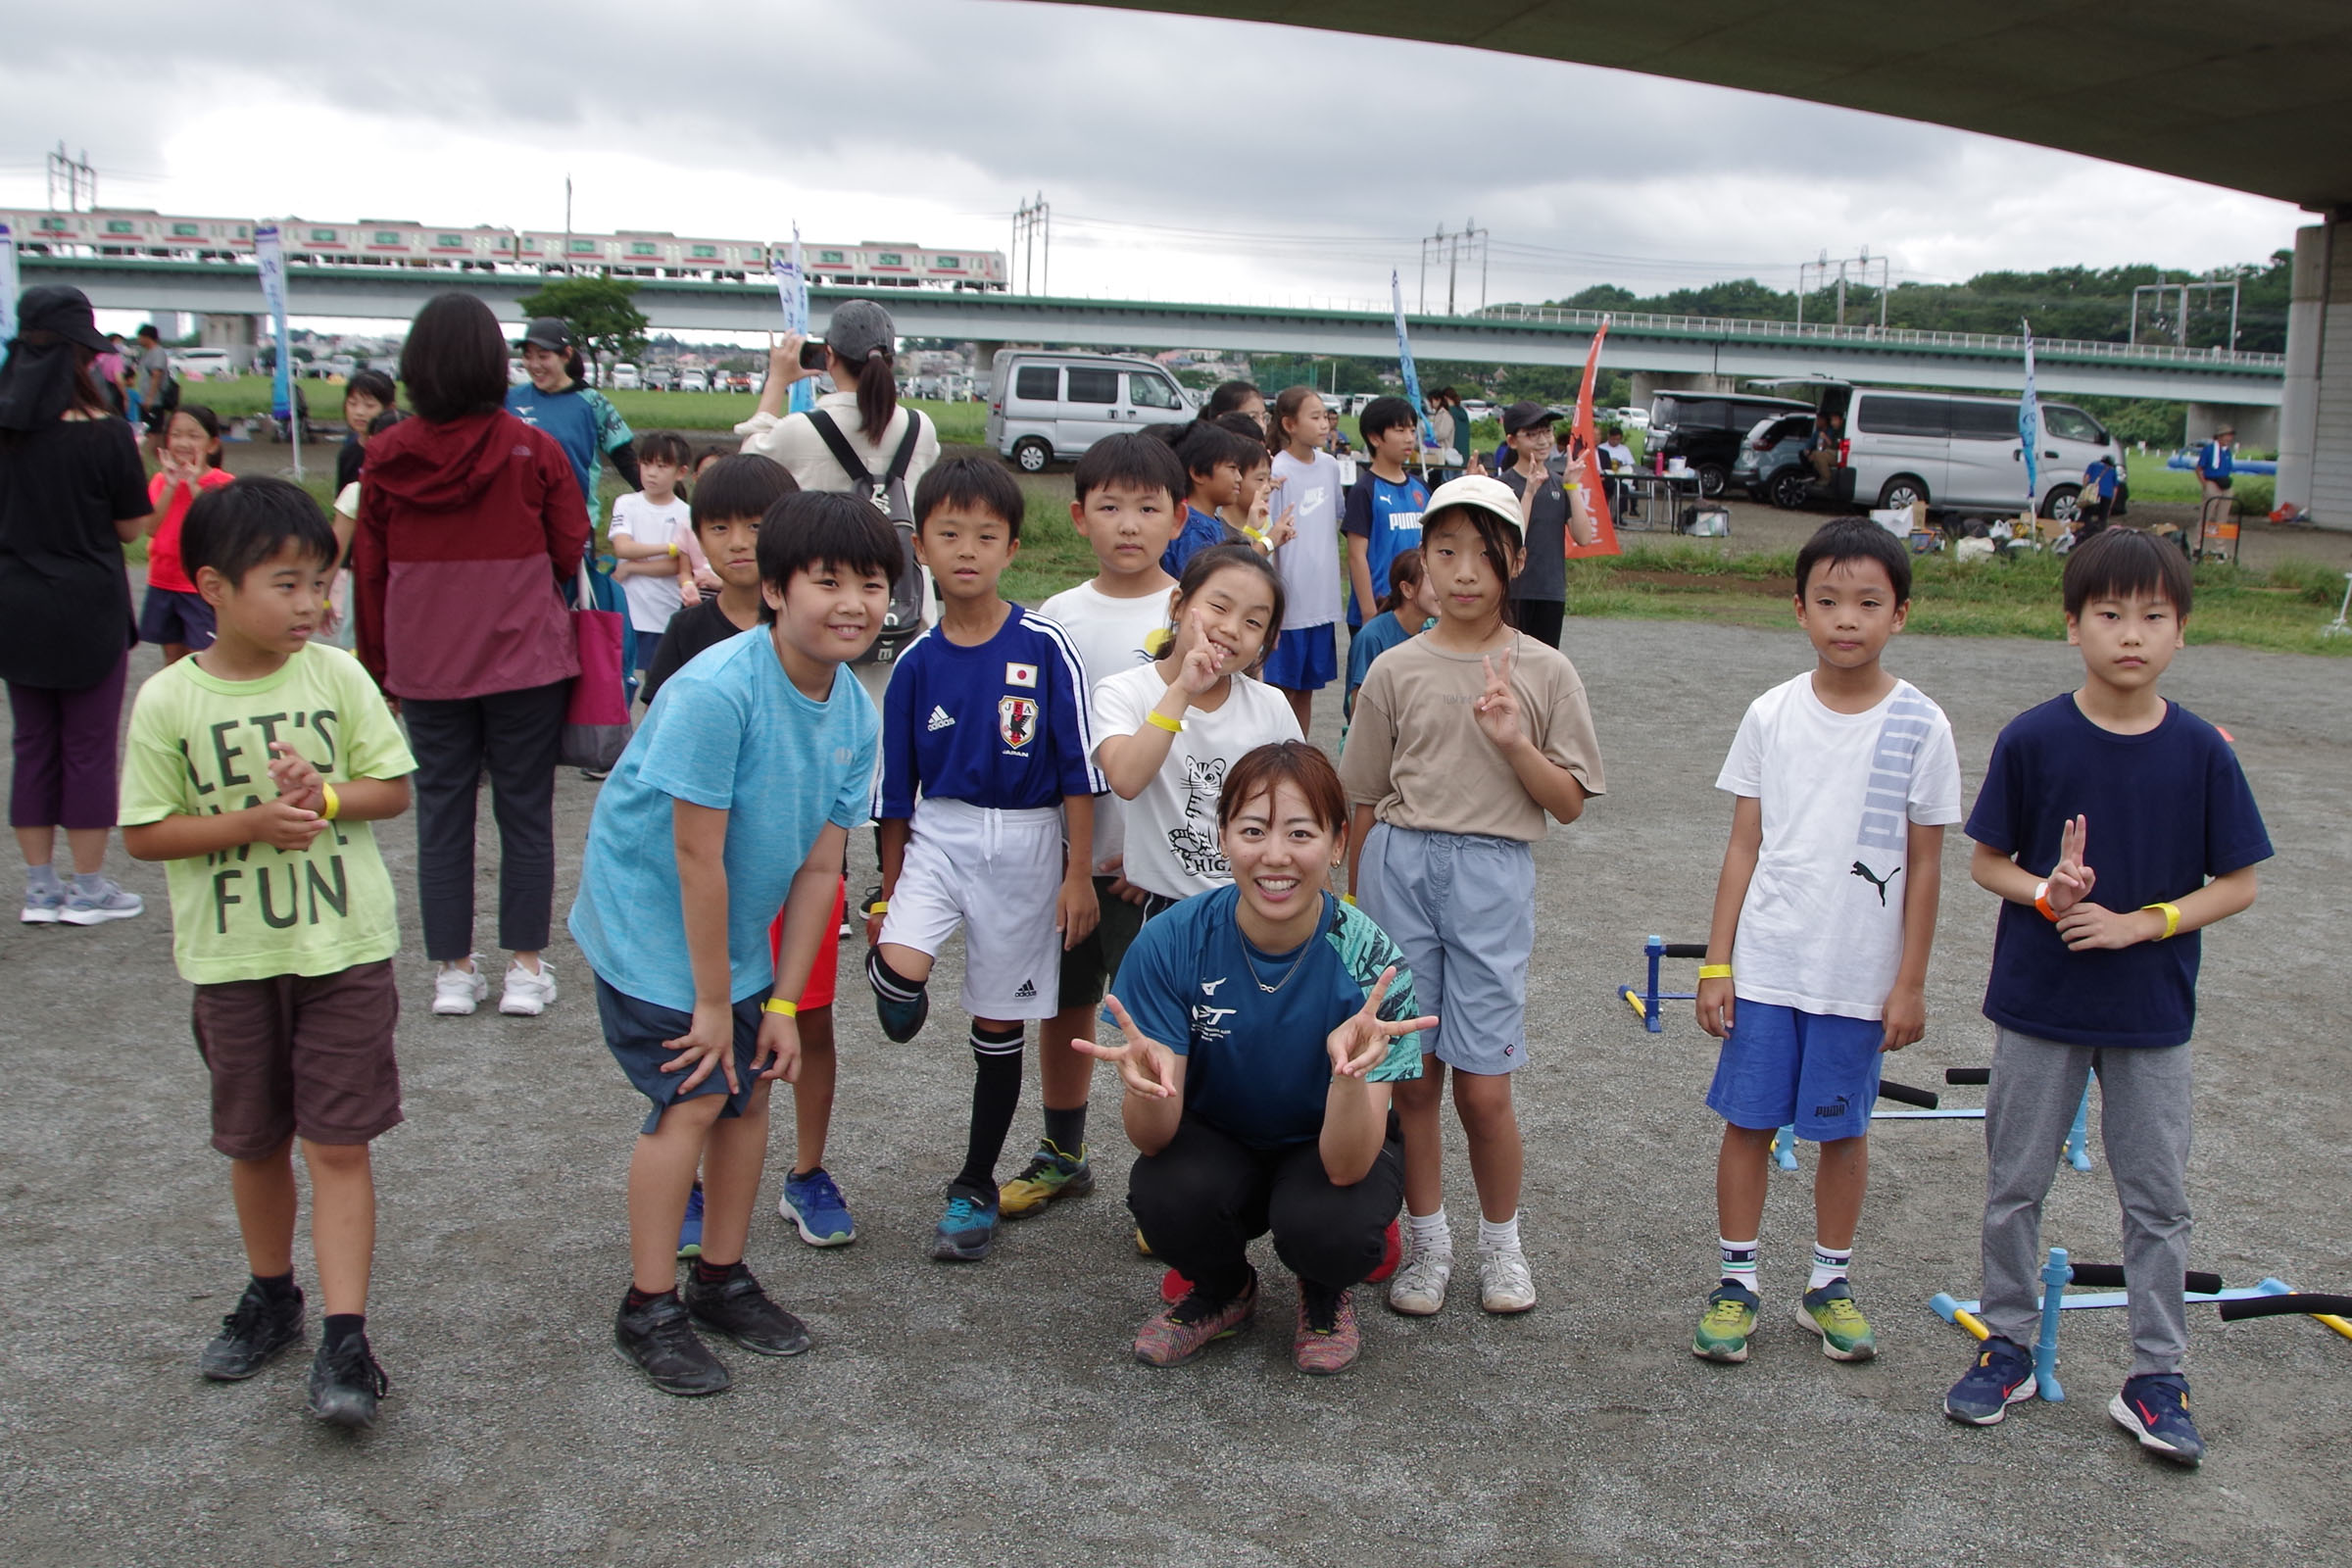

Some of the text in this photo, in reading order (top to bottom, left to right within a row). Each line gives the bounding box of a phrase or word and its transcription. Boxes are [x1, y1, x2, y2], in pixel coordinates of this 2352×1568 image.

[927, 716, 956, 732] adidas
[179, 710, 338, 795] LET'S
[213, 855, 348, 934] FUN
[1814, 1104, 1845, 1117] PUMA
